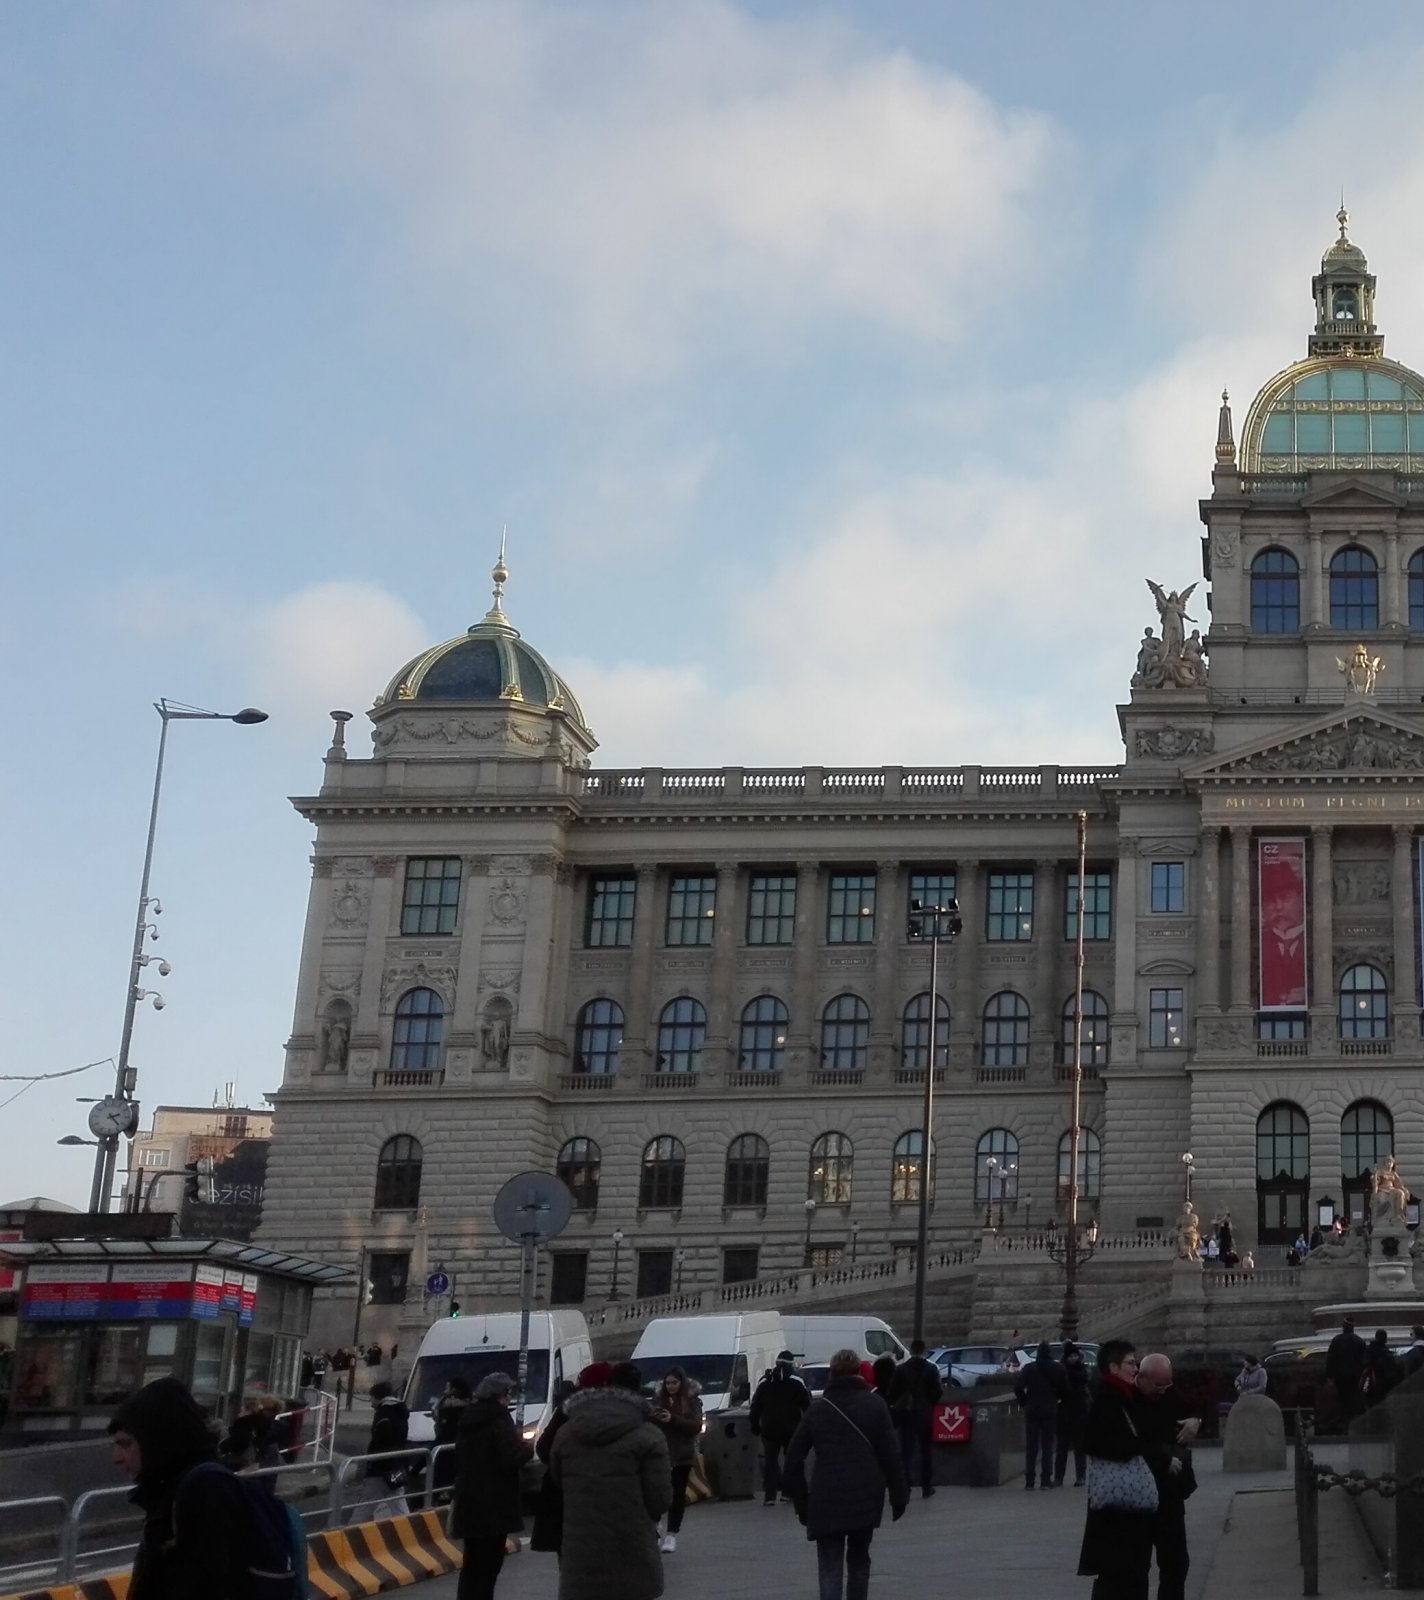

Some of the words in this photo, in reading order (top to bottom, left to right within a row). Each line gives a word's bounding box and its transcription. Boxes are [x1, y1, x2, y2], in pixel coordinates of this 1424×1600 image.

[1225, 796, 1305, 808] MUSEUM
[1326, 796, 1387, 808] REGNI
[1263, 845, 1279, 854] CZ
